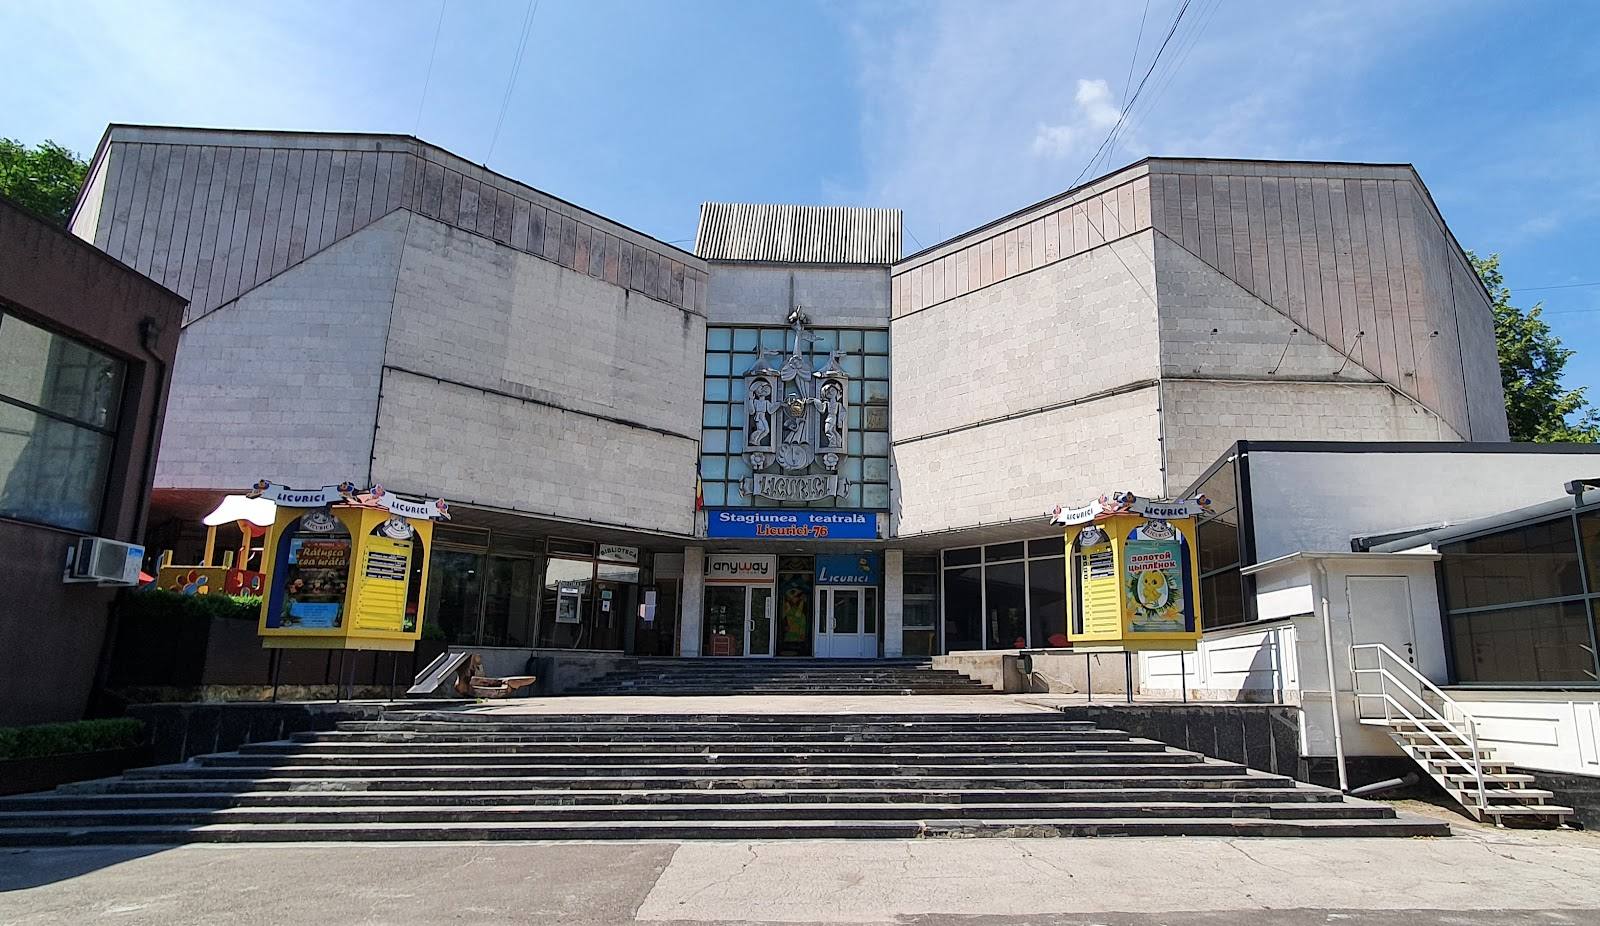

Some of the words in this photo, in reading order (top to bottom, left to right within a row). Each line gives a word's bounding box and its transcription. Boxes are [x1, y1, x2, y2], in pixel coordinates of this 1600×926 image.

[762, 476, 829, 498] LICURICI
[277, 493, 326, 503] LICURICI
[391, 502, 428, 515] LICURICI
[1066, 508, 1094, 520] LICURICI
[1145, 506, 1188, 516] LICURICI
[719, 512, 798, 524] Stagiunea
[809, 513, 866, 523] teatrală
[756, 524, 829, 537] Licurici-76
[600, 547, 637, 558] BIBLIOTECA
[1131, 551, 1171, 562] ЗОЛОТОЙ
[713, 561, 769, 574] anyway
[1128, 562, 1176, 572] ЦЫПЛЁНОК
